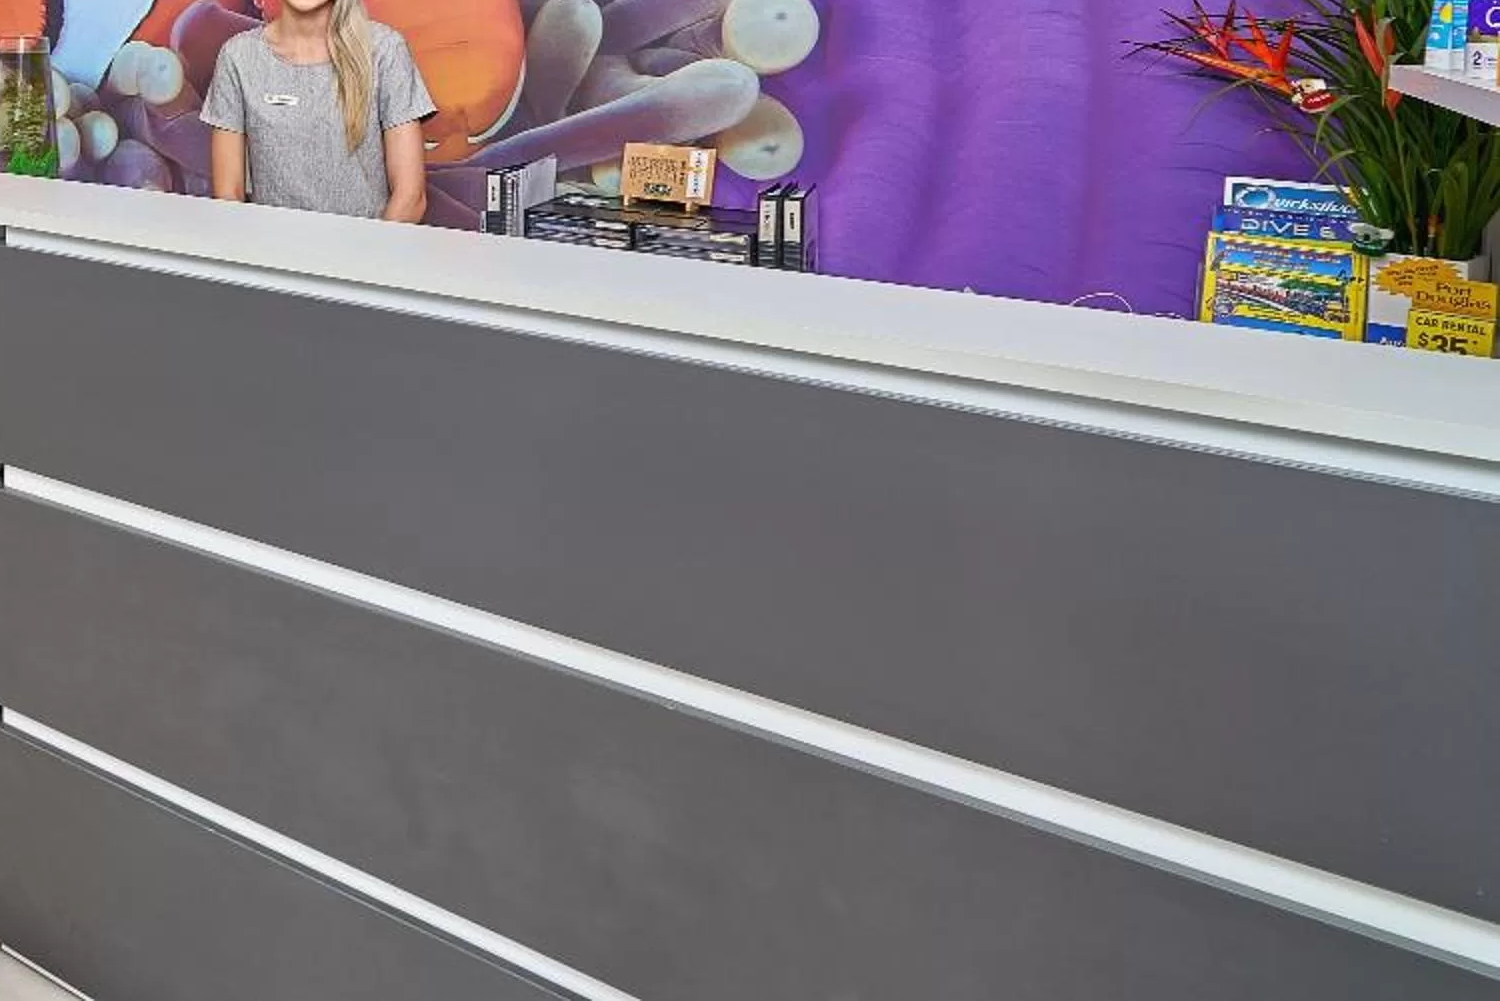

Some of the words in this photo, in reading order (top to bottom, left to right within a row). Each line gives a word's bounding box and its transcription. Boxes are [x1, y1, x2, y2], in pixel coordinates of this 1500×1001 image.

[1240, 218, 1311, 236] DIVE
[1436, 282, 1472, 296] Port
[1415, 290, 1492, 309] Douglas
[1415, 316, 1439, 328] CAR
[1441, 320, 1486, 336] RENTAL
